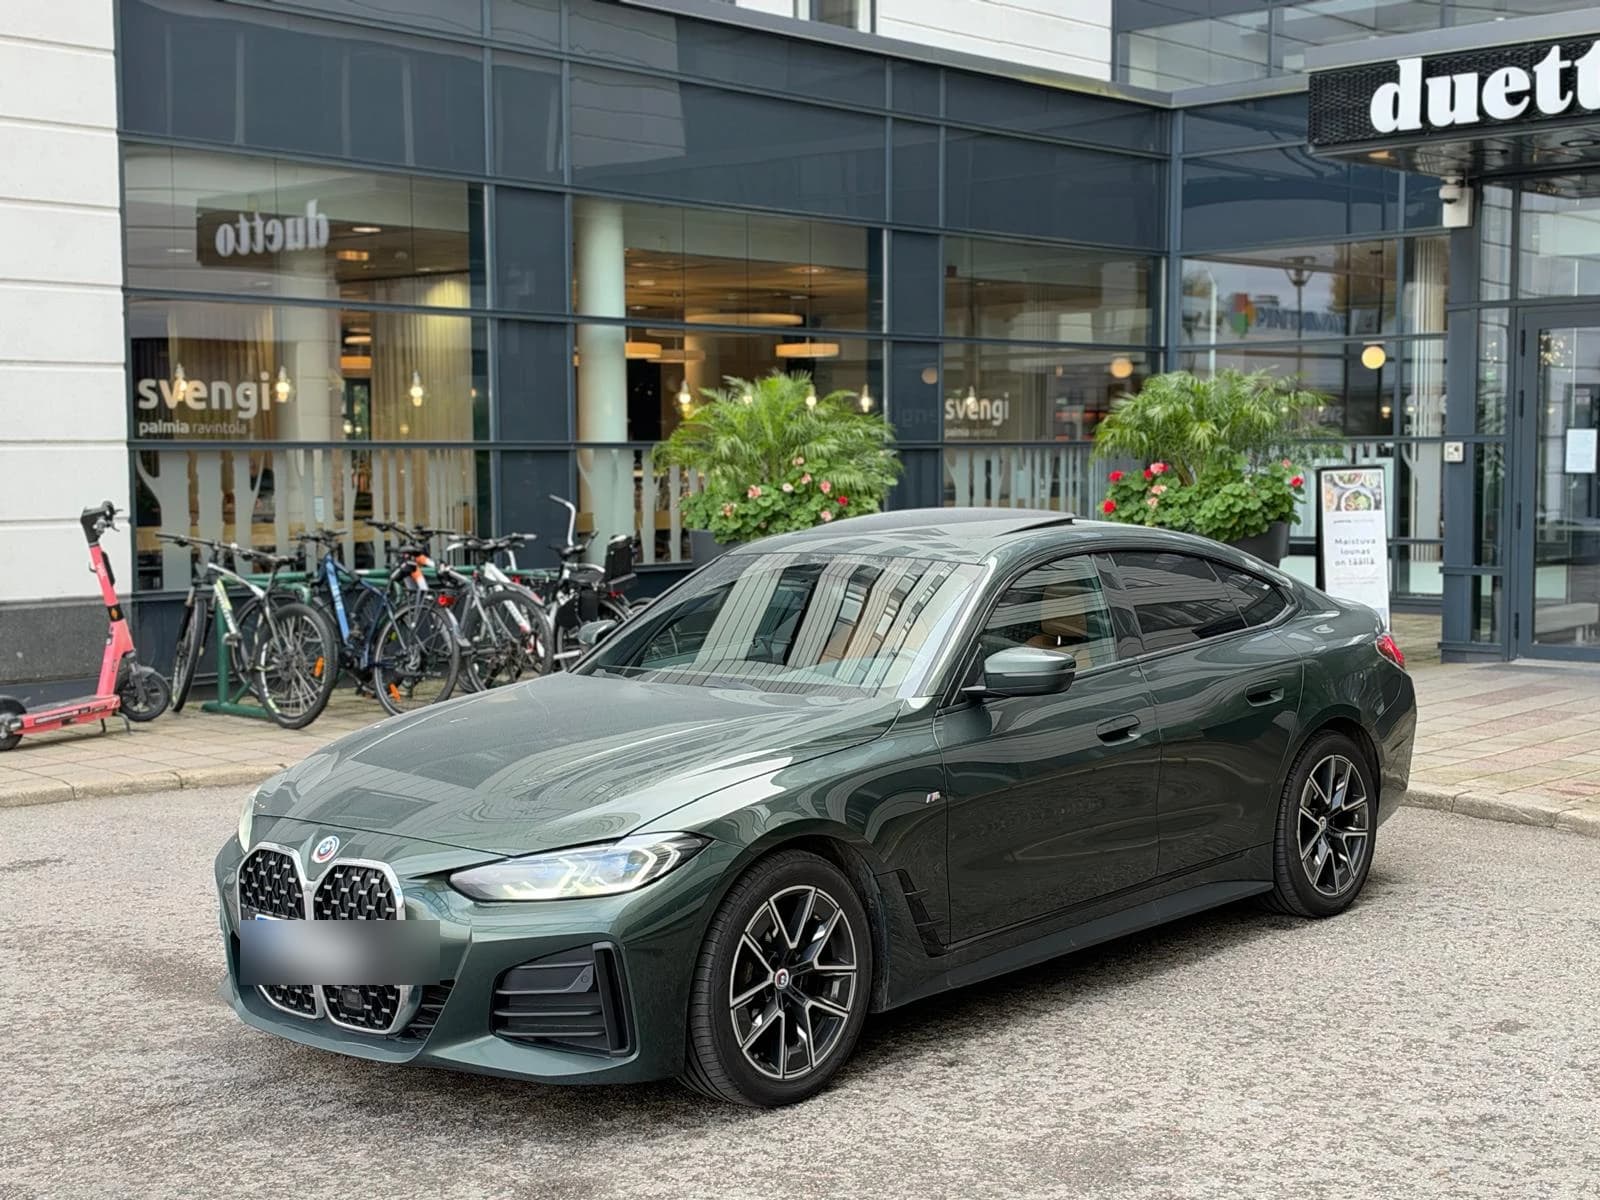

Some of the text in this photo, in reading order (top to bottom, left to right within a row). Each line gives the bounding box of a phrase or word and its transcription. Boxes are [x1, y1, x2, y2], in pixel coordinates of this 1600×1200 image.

[137, 371, 271, 419] svengi
[944, 391, 1010, 426] svengi
[138, 419, 247, 437] palmia ravintola
